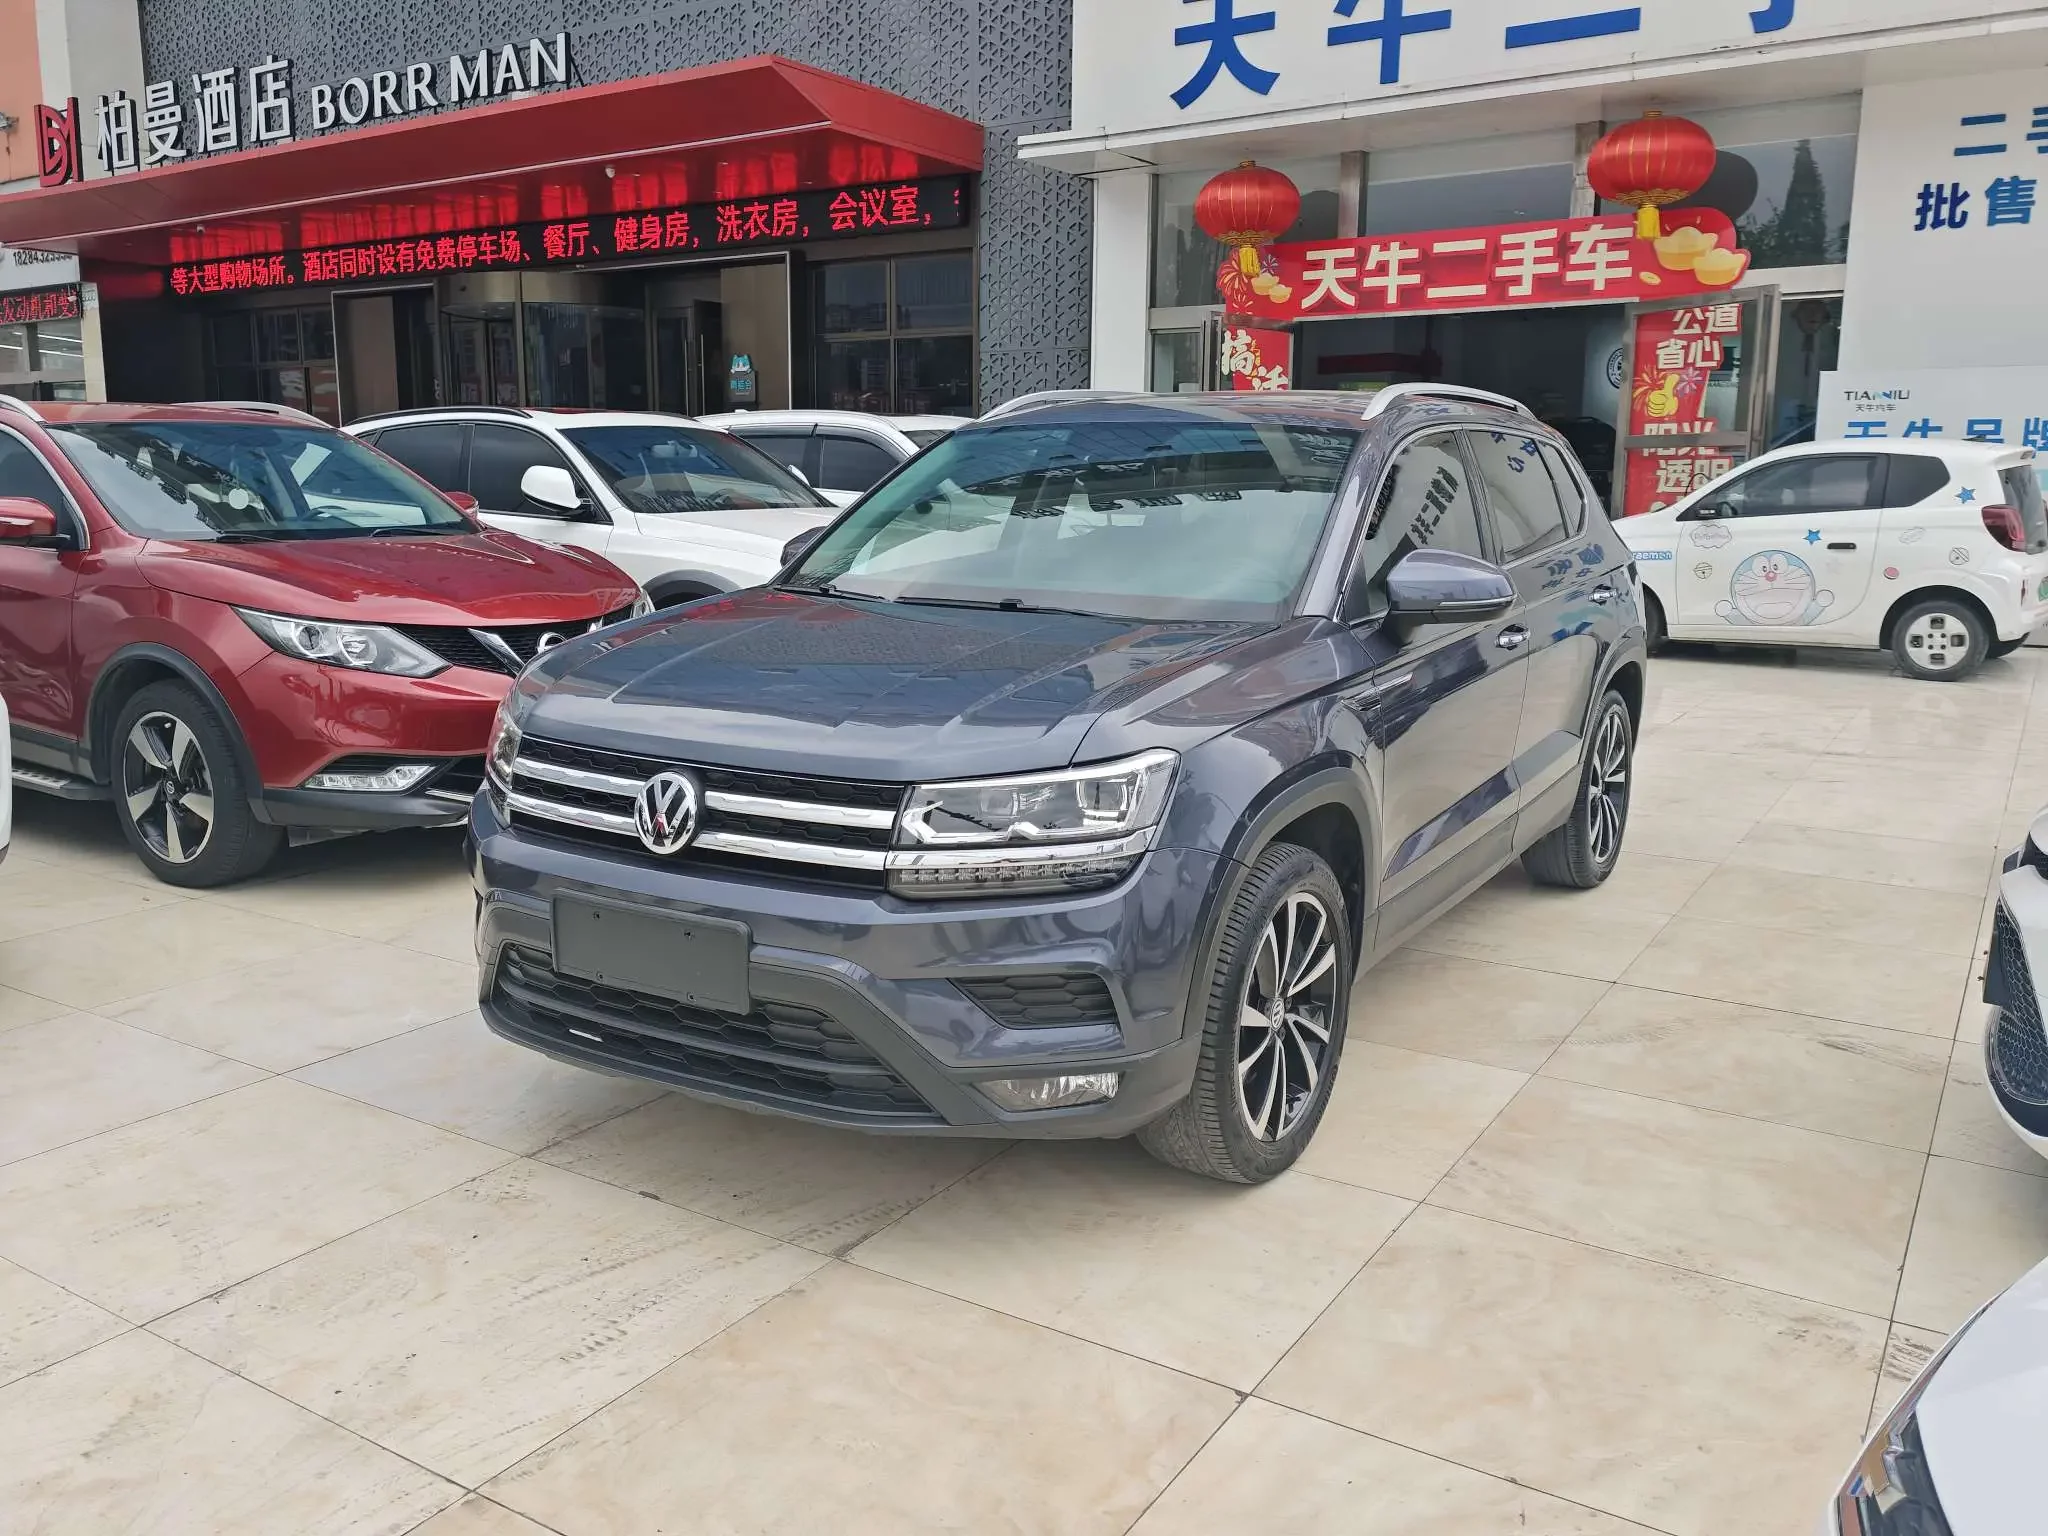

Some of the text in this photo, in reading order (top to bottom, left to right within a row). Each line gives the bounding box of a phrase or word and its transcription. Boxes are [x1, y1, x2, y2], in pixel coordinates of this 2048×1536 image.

[1170, 0, 1795, 109] 天牛
[96, 55, 295, 171] 柏曼酒店
[1914, 175, 2037, 231] 批售
[1301, 224, 1634, 310] 天牛二手车
[1672, 303, 1740, 335] 公道
[1656, 336, 1721, 369] 省心
[1656, 458, 1731, 493] 透明
[1632, 550, 1672, 561] raemon
